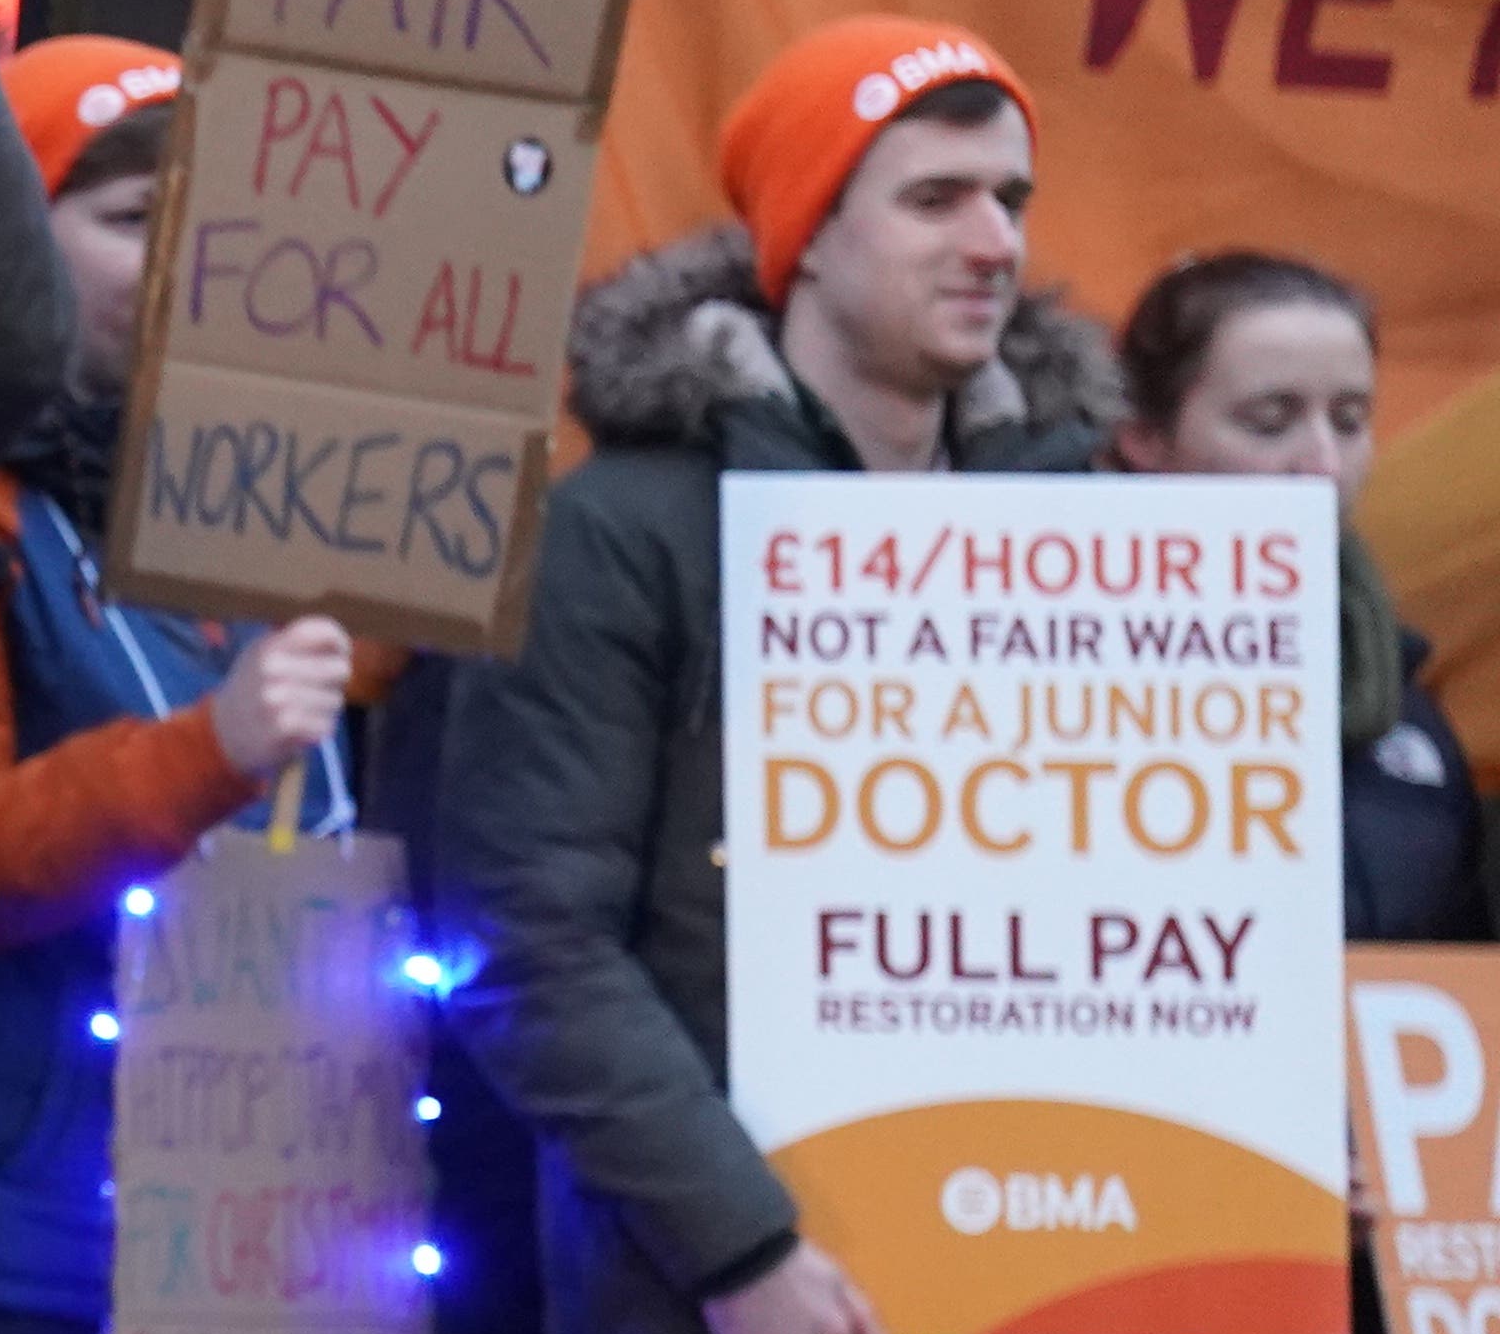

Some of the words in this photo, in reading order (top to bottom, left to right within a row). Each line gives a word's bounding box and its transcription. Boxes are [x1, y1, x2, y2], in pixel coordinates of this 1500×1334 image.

[252, 77, 440, 218] PAY
[188, 218, 384, 347] FOR
[411, 261, 537, 376] ALL
[148, 419, 513, 580] WORKERS
[759, 525, 1202, 598] £14/HOUR
[1234, 534, 1300, 598] IS
[759, 612, 888, 662] NOT
[908, 614, 950, 663] A
[969, 614, 1103, 665] FAIR
[1125, 614, 1302, 667] WAGE
[761, 679, 914, 740] FOR
[942, 683, 991, 741] A
[1014, 680, 1303, 750] JUNIOR
[762, 756, 1305, 860] DOCTOR
[816, 909, 1058, 983] FULL
[1089, 914, 1256, 985] PAY
[817, 994, 1134, 1034] RESTORATION
[1150, 998, 1258, 1036] NOW
[1005, 1173, 1136, 1231] BMA
